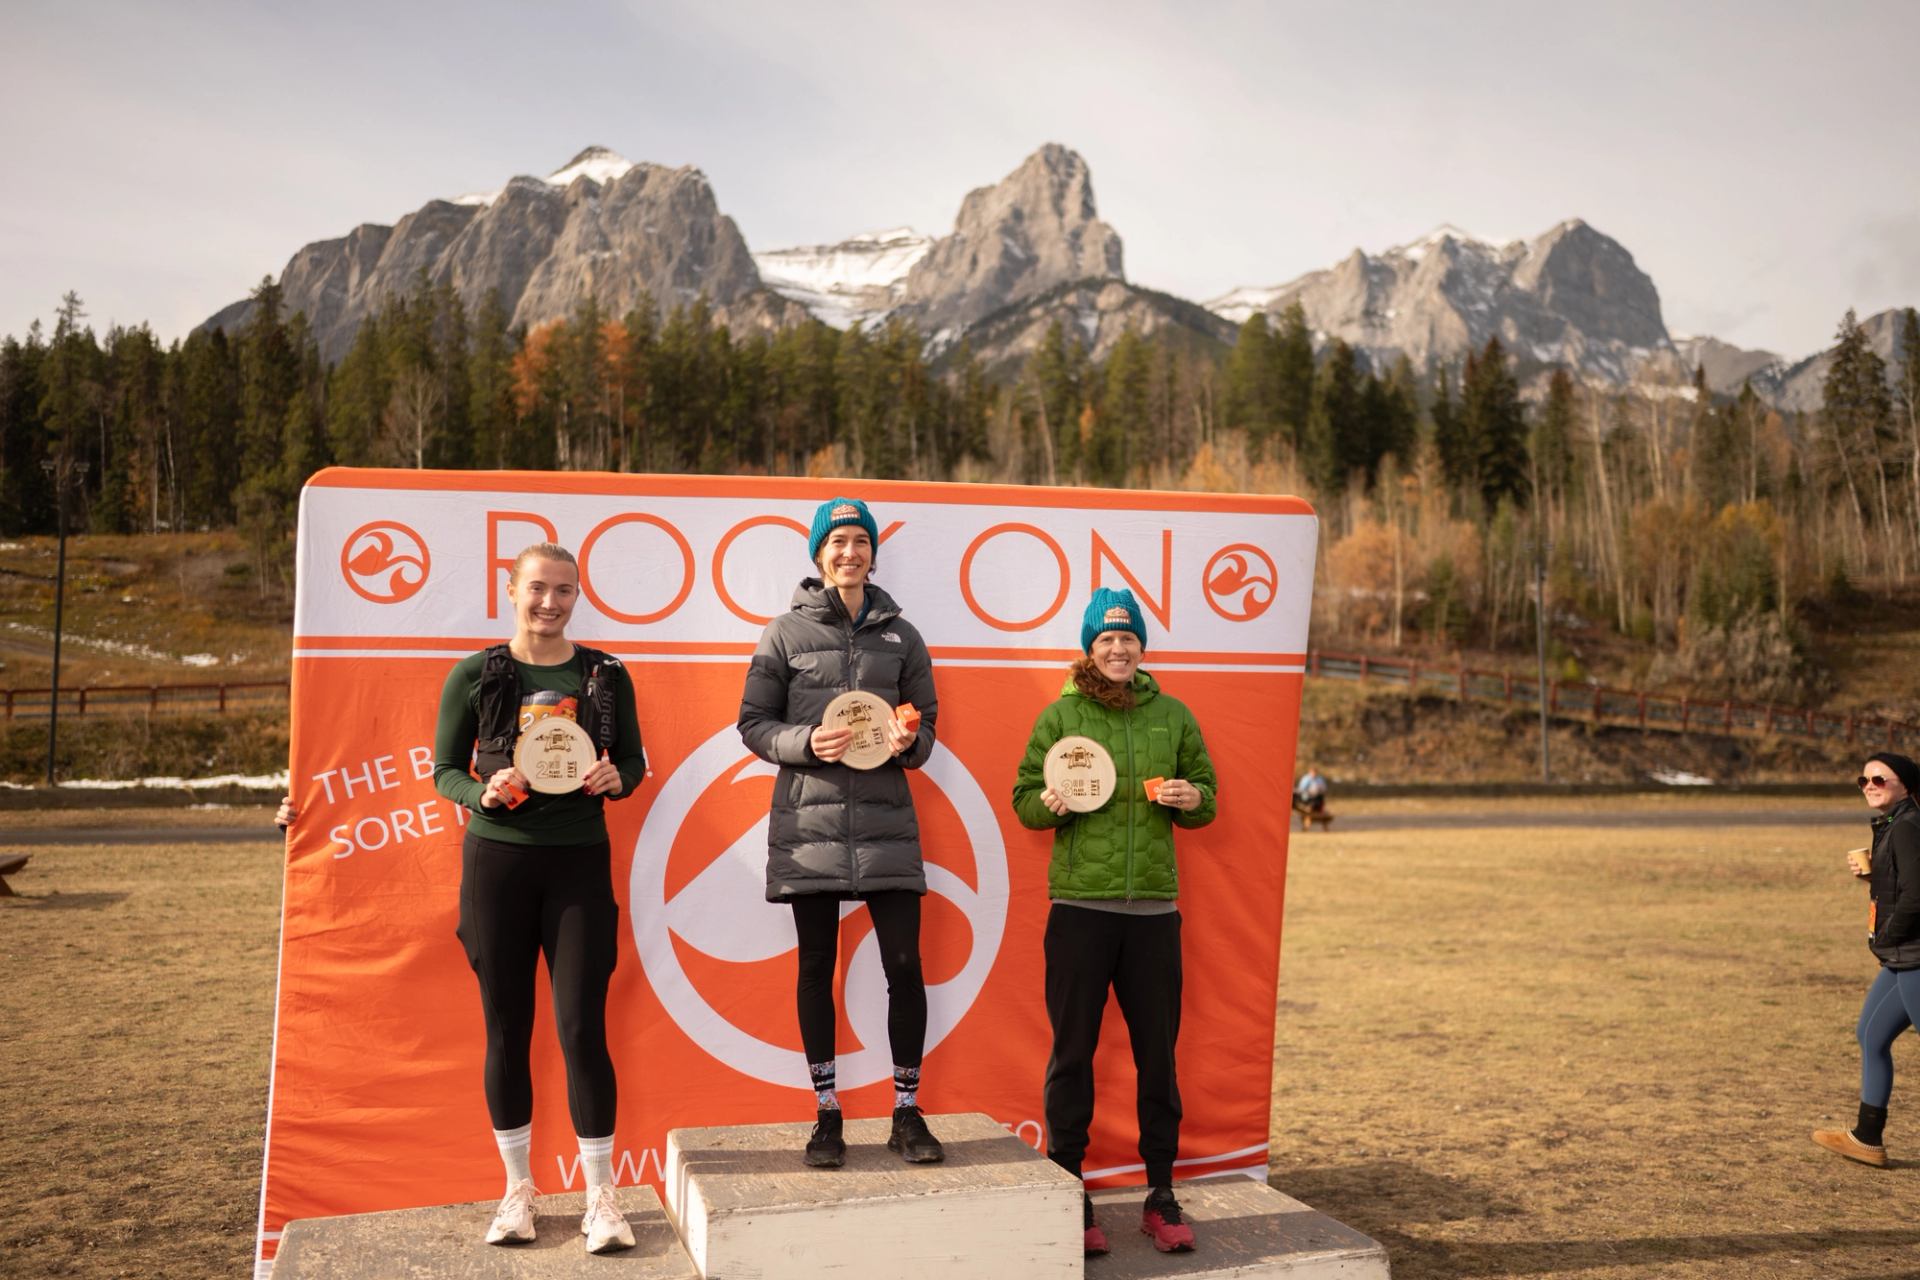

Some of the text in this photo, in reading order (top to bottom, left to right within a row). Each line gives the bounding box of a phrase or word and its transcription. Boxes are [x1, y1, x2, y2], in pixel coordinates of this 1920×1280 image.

[487, 510, 1172, 632] ROC ON
[312, 754, 401, 805] THE
[329, 800, 444, 859] SORE
